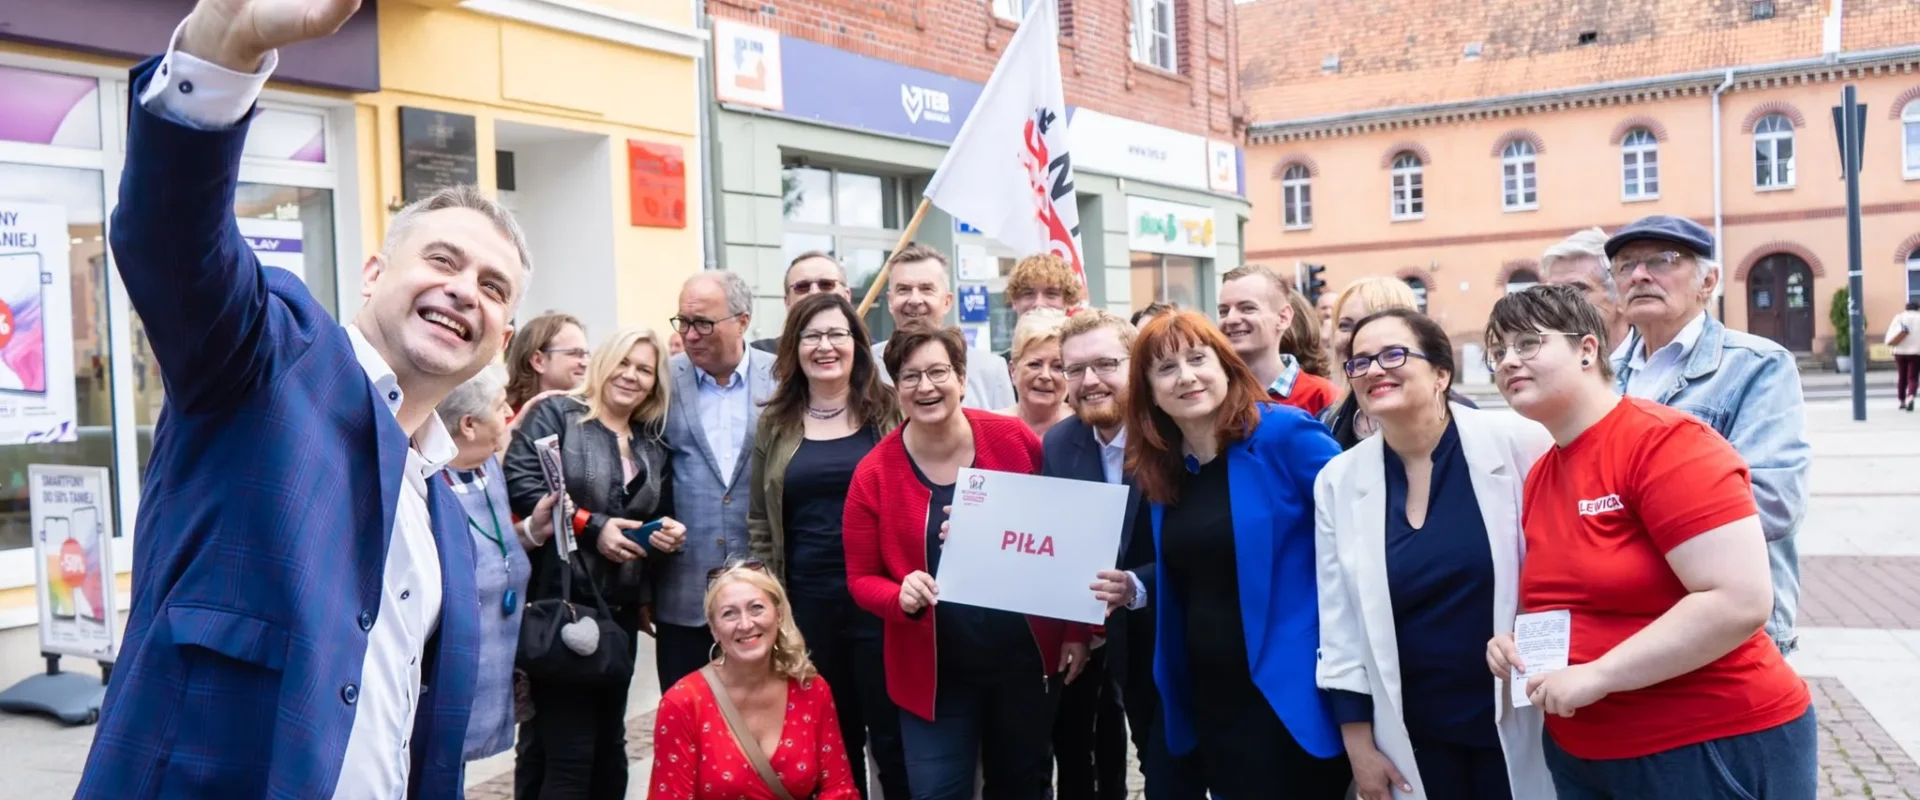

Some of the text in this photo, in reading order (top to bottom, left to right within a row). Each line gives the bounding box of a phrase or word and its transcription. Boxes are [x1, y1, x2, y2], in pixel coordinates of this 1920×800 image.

[923, 88, 949, 113] TEB
[0, 232, 37, 248] NIEJ
[43, 491, 53, 503] DO
[1580, 496, 1620, 513] LEWICA
[1001, 530, 1055, 557] PIŁA
